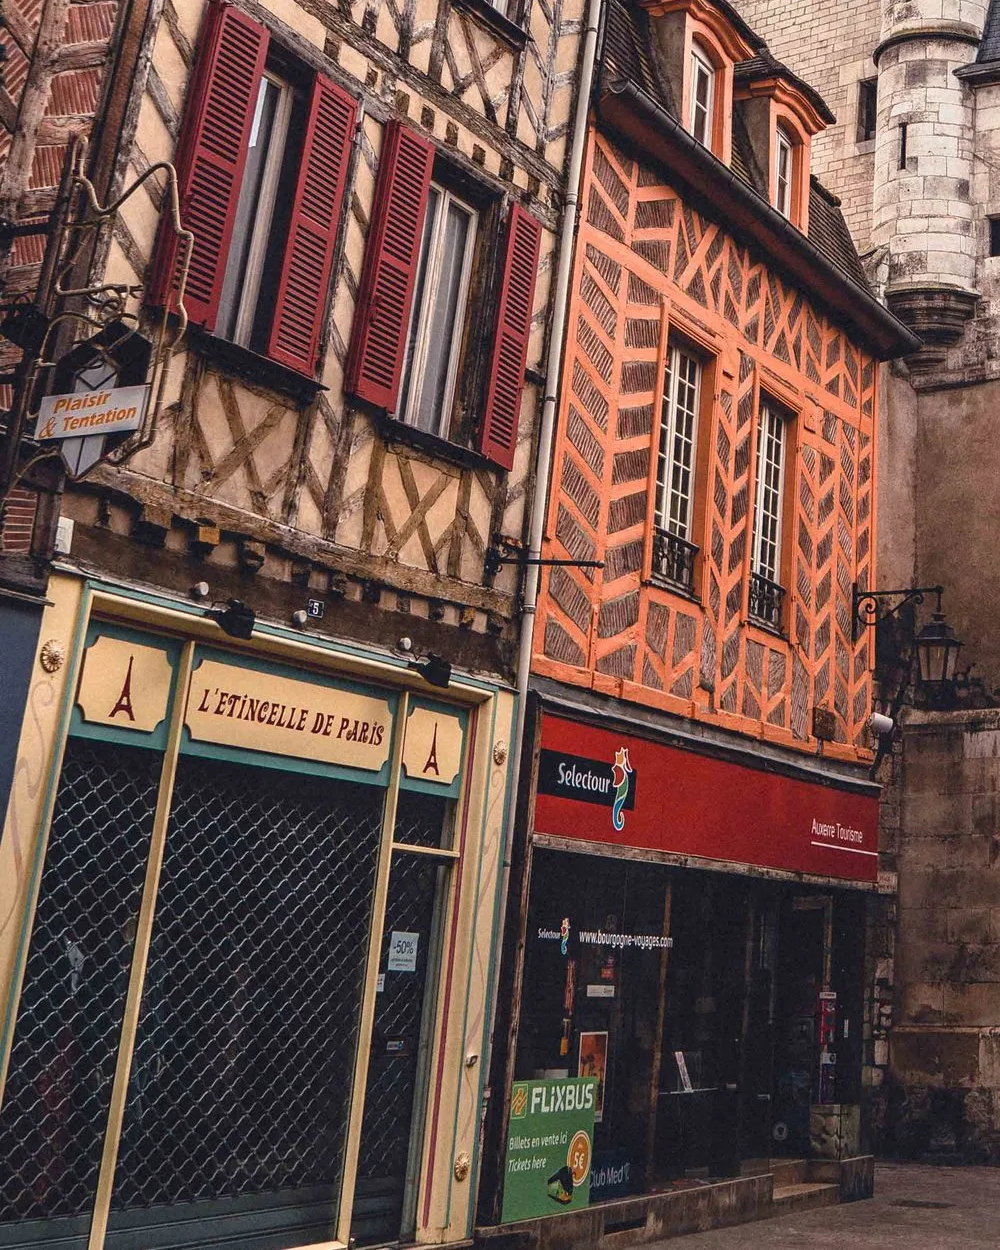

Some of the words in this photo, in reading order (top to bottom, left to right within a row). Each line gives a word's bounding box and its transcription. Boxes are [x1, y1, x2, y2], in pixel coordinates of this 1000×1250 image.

[53, 391, 112, 414] Plaisir
[38, 416, 57, 438] &
[63, 407, 137, 431] Tentation
[311, 712, 335, 737] DE
[557, 762, 611, 793] Selectour
[811, 818, 836, 838] Auxerre
[836, 823, 863, 843] Tourisme
[579, 929, 674, 950] www.bourgogne-voyages.com
[509, 1134, 531, 1150] Billets
[531, 1138, 540, 1148] en
[540, 1134, 559, 1146] vente
[559, 1131, 568, 1145] ici
[508, 1157, 532, 1172] Tickets
[532, 1155, 547, 1170] here
[573, 1152, 585, 1169] 5€
